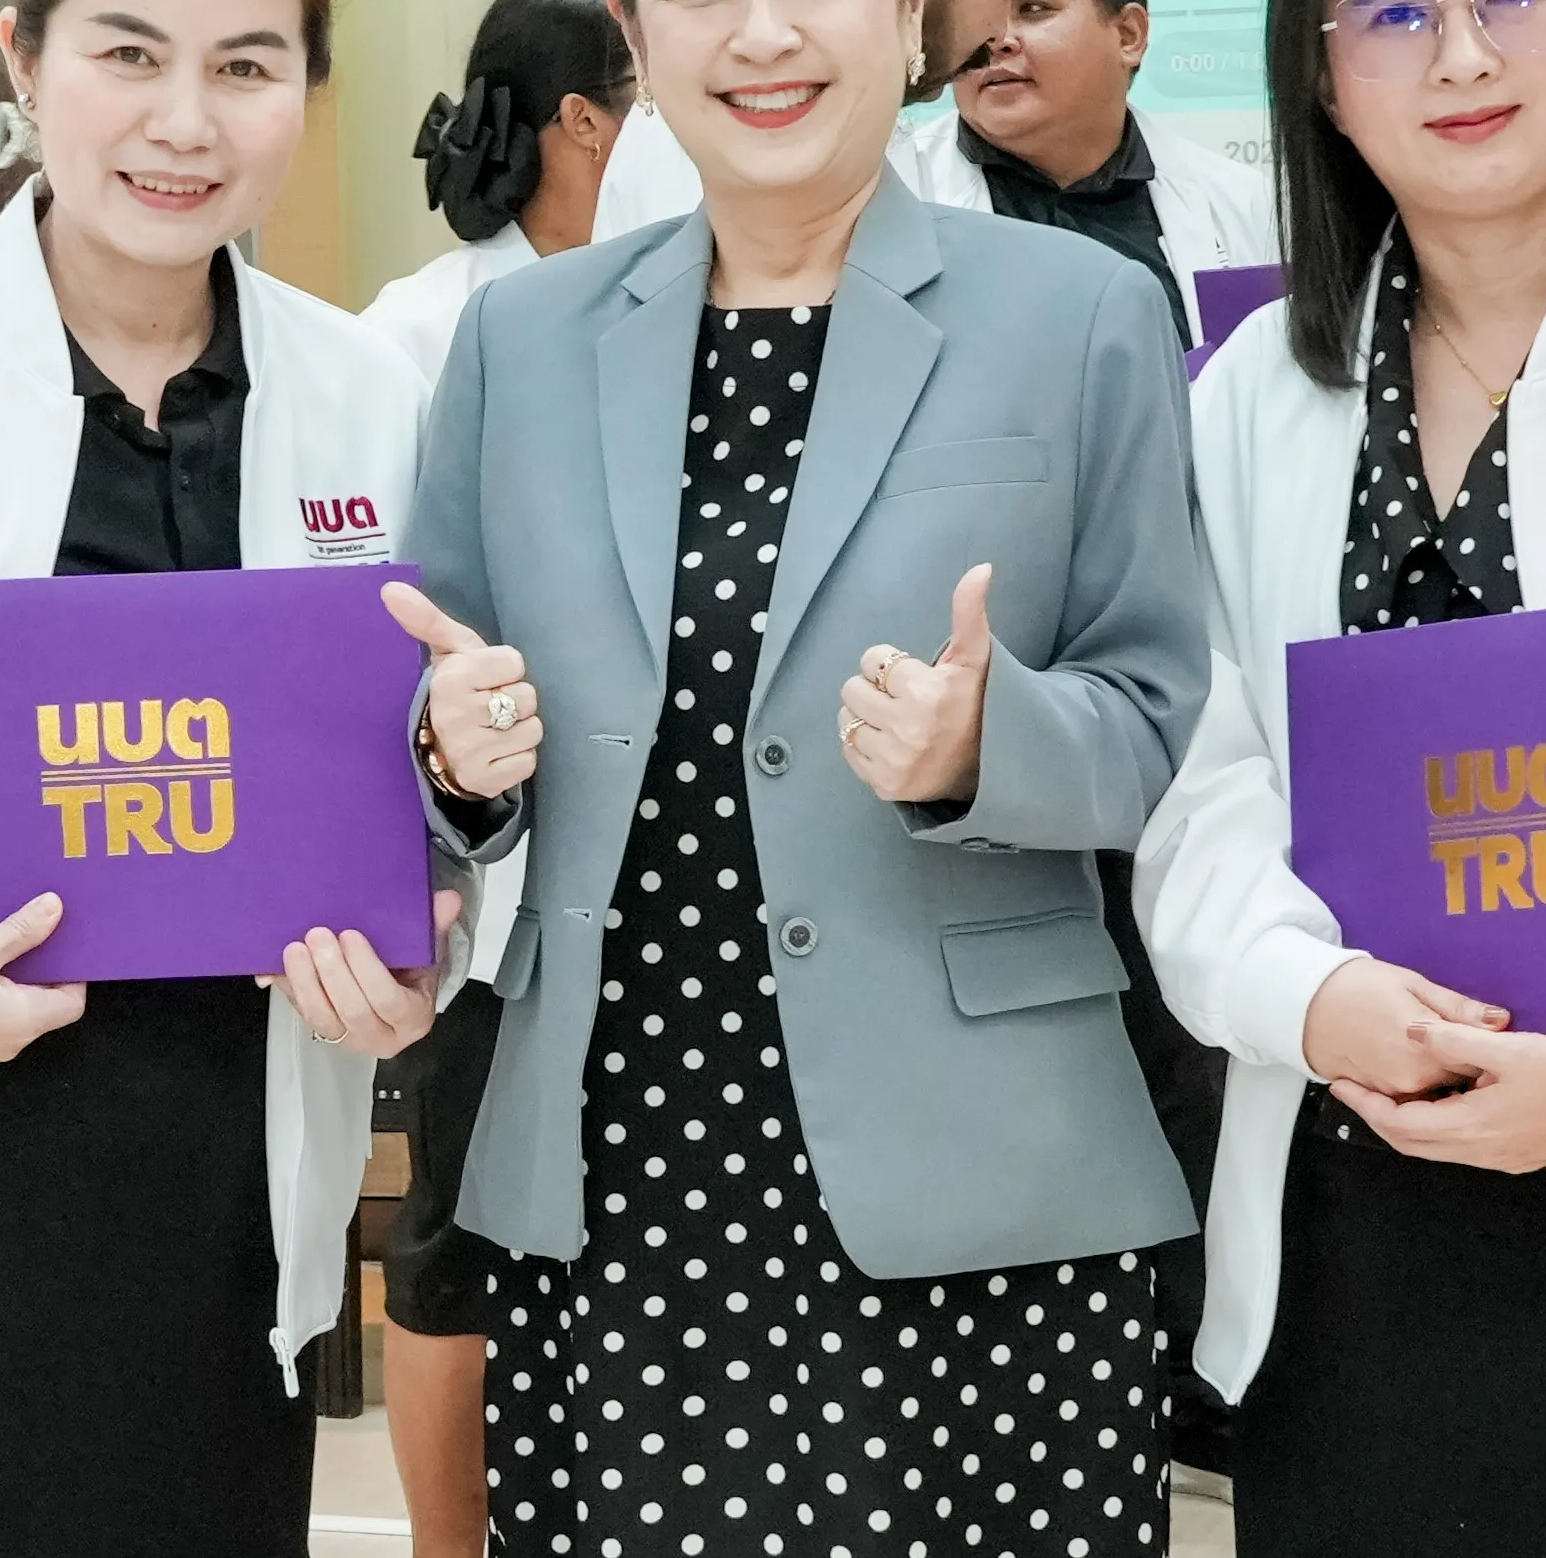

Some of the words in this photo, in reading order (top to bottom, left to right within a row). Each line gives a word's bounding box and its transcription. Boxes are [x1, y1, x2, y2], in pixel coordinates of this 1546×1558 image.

[1170, 52, 1215, 73] 0:00
[1223, 140, 1274, 165] 202
[41, 778, 237, 859] TRU
